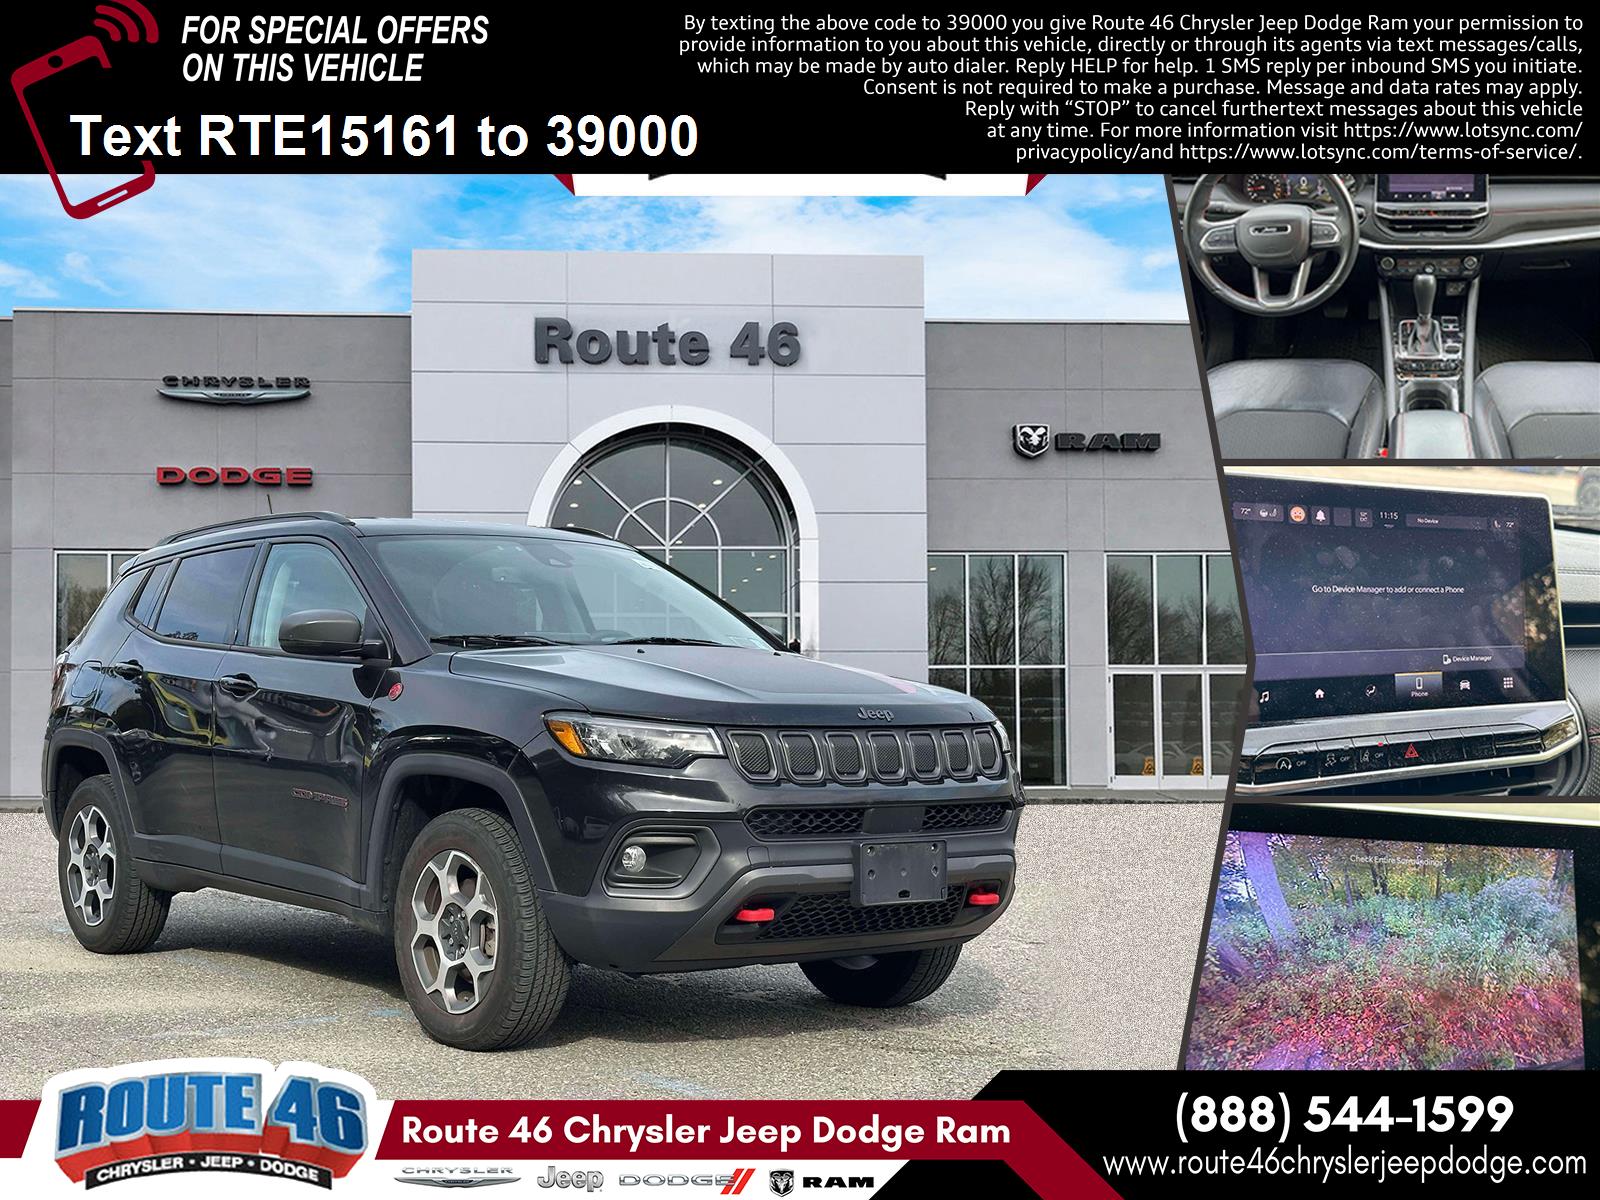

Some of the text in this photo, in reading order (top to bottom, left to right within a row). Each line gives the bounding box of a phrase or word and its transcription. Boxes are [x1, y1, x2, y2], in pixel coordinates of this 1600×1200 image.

[534, 317, 801, 367] Route 46
[162, 375, 311, 387] CHRYSLER
[1055, 432, 1161, 451] RAM
[156, 467, 313, 486] DODGE
[1380, 511, 1399, 520] 11:15
[1311, 584, 1323, 593] Go
[1323, 585, 1332, 593] to
[1332, 585, 1356, 593] Device
[1356, 585, 1386, 594] Manager
[857, 706, 895, 722] Jeep
